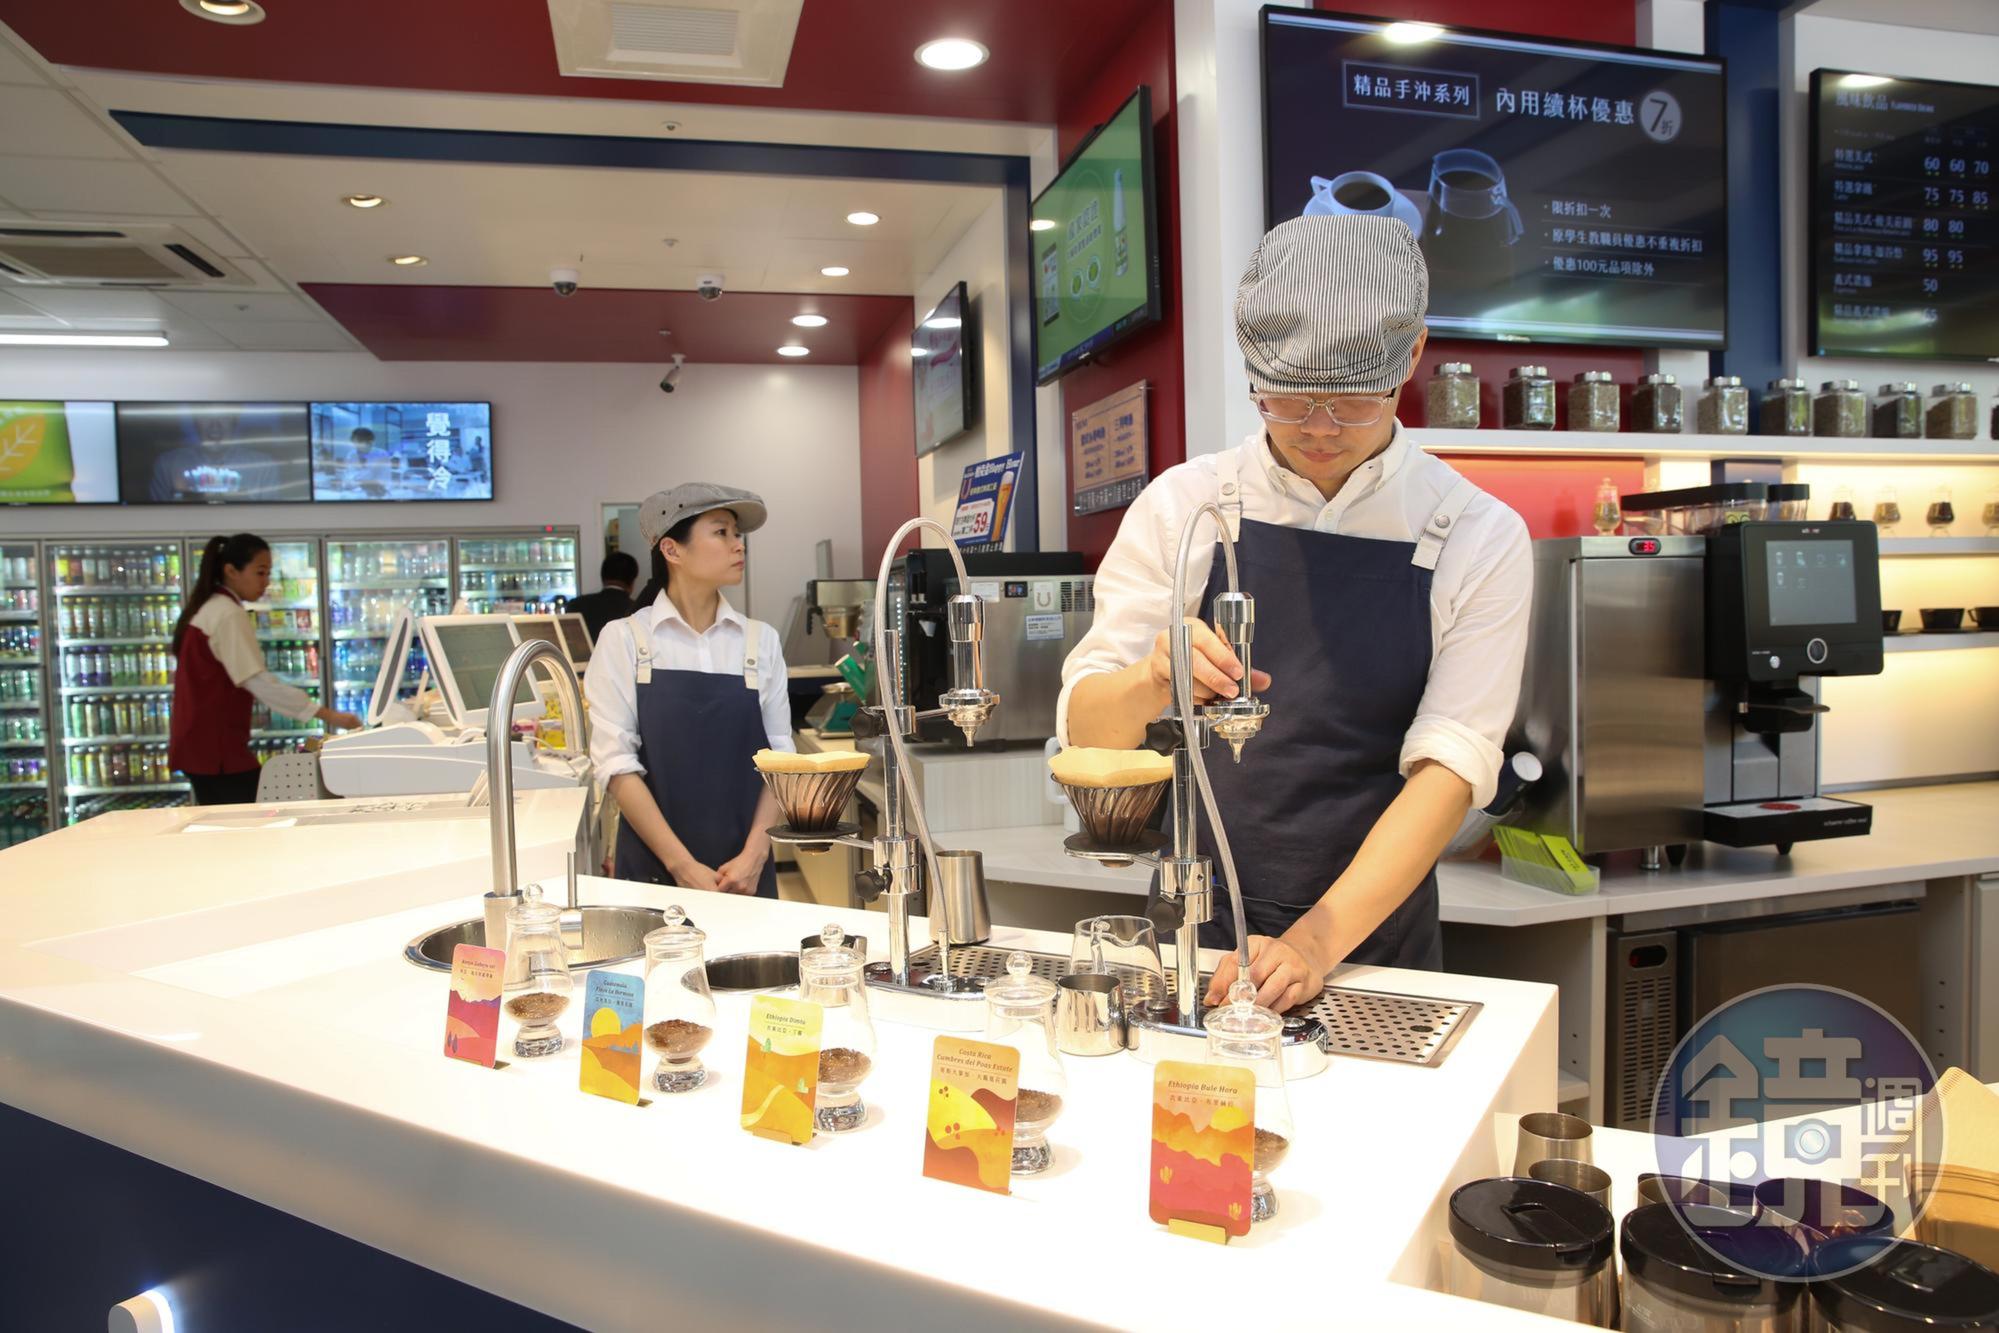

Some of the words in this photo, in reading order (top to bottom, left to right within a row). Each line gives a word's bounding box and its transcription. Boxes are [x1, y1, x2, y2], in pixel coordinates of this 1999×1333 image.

[1353, 74, 1470, 107] 精品手沖系列
[1496, 87, 1635, 125] 內用續杯優惠
[1924, 156, 1941, 170] 60
[1949, 159, 1965, 172] 60
[1973, 161, 1990, 174] 70
[1924, 187, 1940, 201] 75
[1949, 189, 1965, 203] 75
[1972, 191, 1988, 205] 85
[1923, 218, 1939, 232] 80
[1948, 220, 1964, 233] 80
[1923, 249, 1938, 262] 95
[1947, 250, 1964, 264] 95
[1923, 278, 1938, 292] 50
[425, 412, 452, 490] 覺得冷
[959, 1048, 976, 1057] Costa
[977, 1051, 992, 1060] Rica
[936, 1054, 964, 1064] Cumbres
[965, 1058, 976, 1066] del
[992, 1063, 1013, 1073] Estate
[1167, 1079, 1199, 1090] Ethiopia
[1219, 1085, 1238, 1095] Hora
